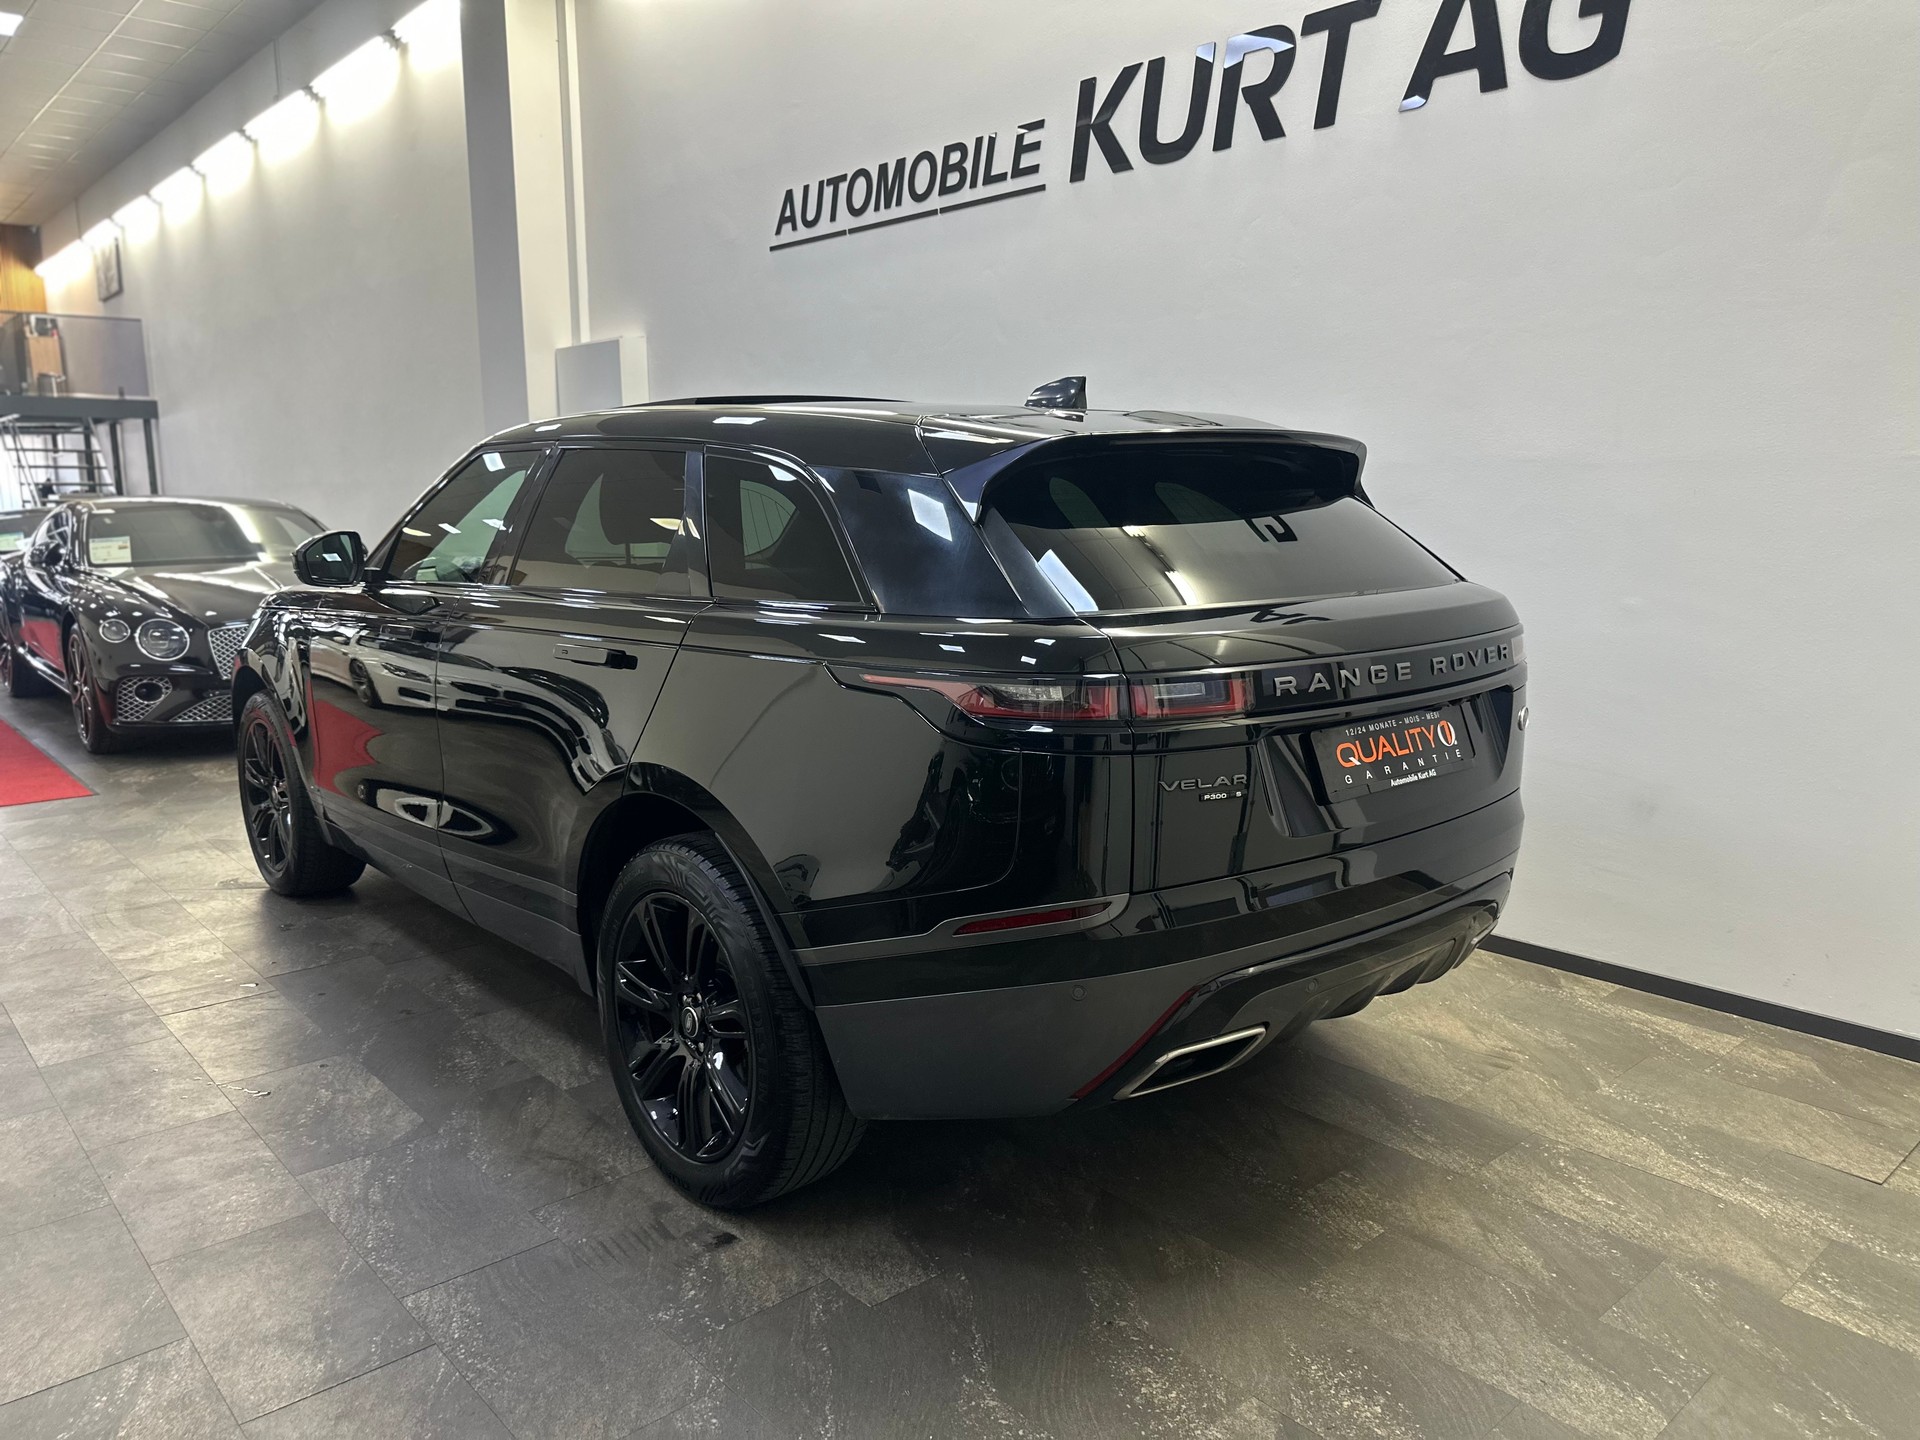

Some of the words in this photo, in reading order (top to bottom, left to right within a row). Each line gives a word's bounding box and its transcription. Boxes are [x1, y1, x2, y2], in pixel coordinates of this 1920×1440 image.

[775, 118, 1045, 236] AUTOMOBILE
[1069, 0, 1382, 184] KURT
[1398, 0, 1632, 112] AG
[1274, 661, 1412, 697] RANGE
[1430, 643, 1510, 676] ROVER
[1345, 725, 1367, 737] 12/24
[1368, 720, 1397, 731] MONATE
[1404, 714, 1420, 724] MOIS
[1426, 711, 1440, 720] MESI
[1336, 724, 1436, 768] QUALITY
[1158, 774, 1247, 791] VELAR
[1344, 749, 1462, 785] GARANTIE
[1390, 774, 1418, 787] Automobile
[1418, 770, 1429, 782] Kurt
[1428, 768, 1437, 778] AG
[1203, 792, 1227, 801] P300
